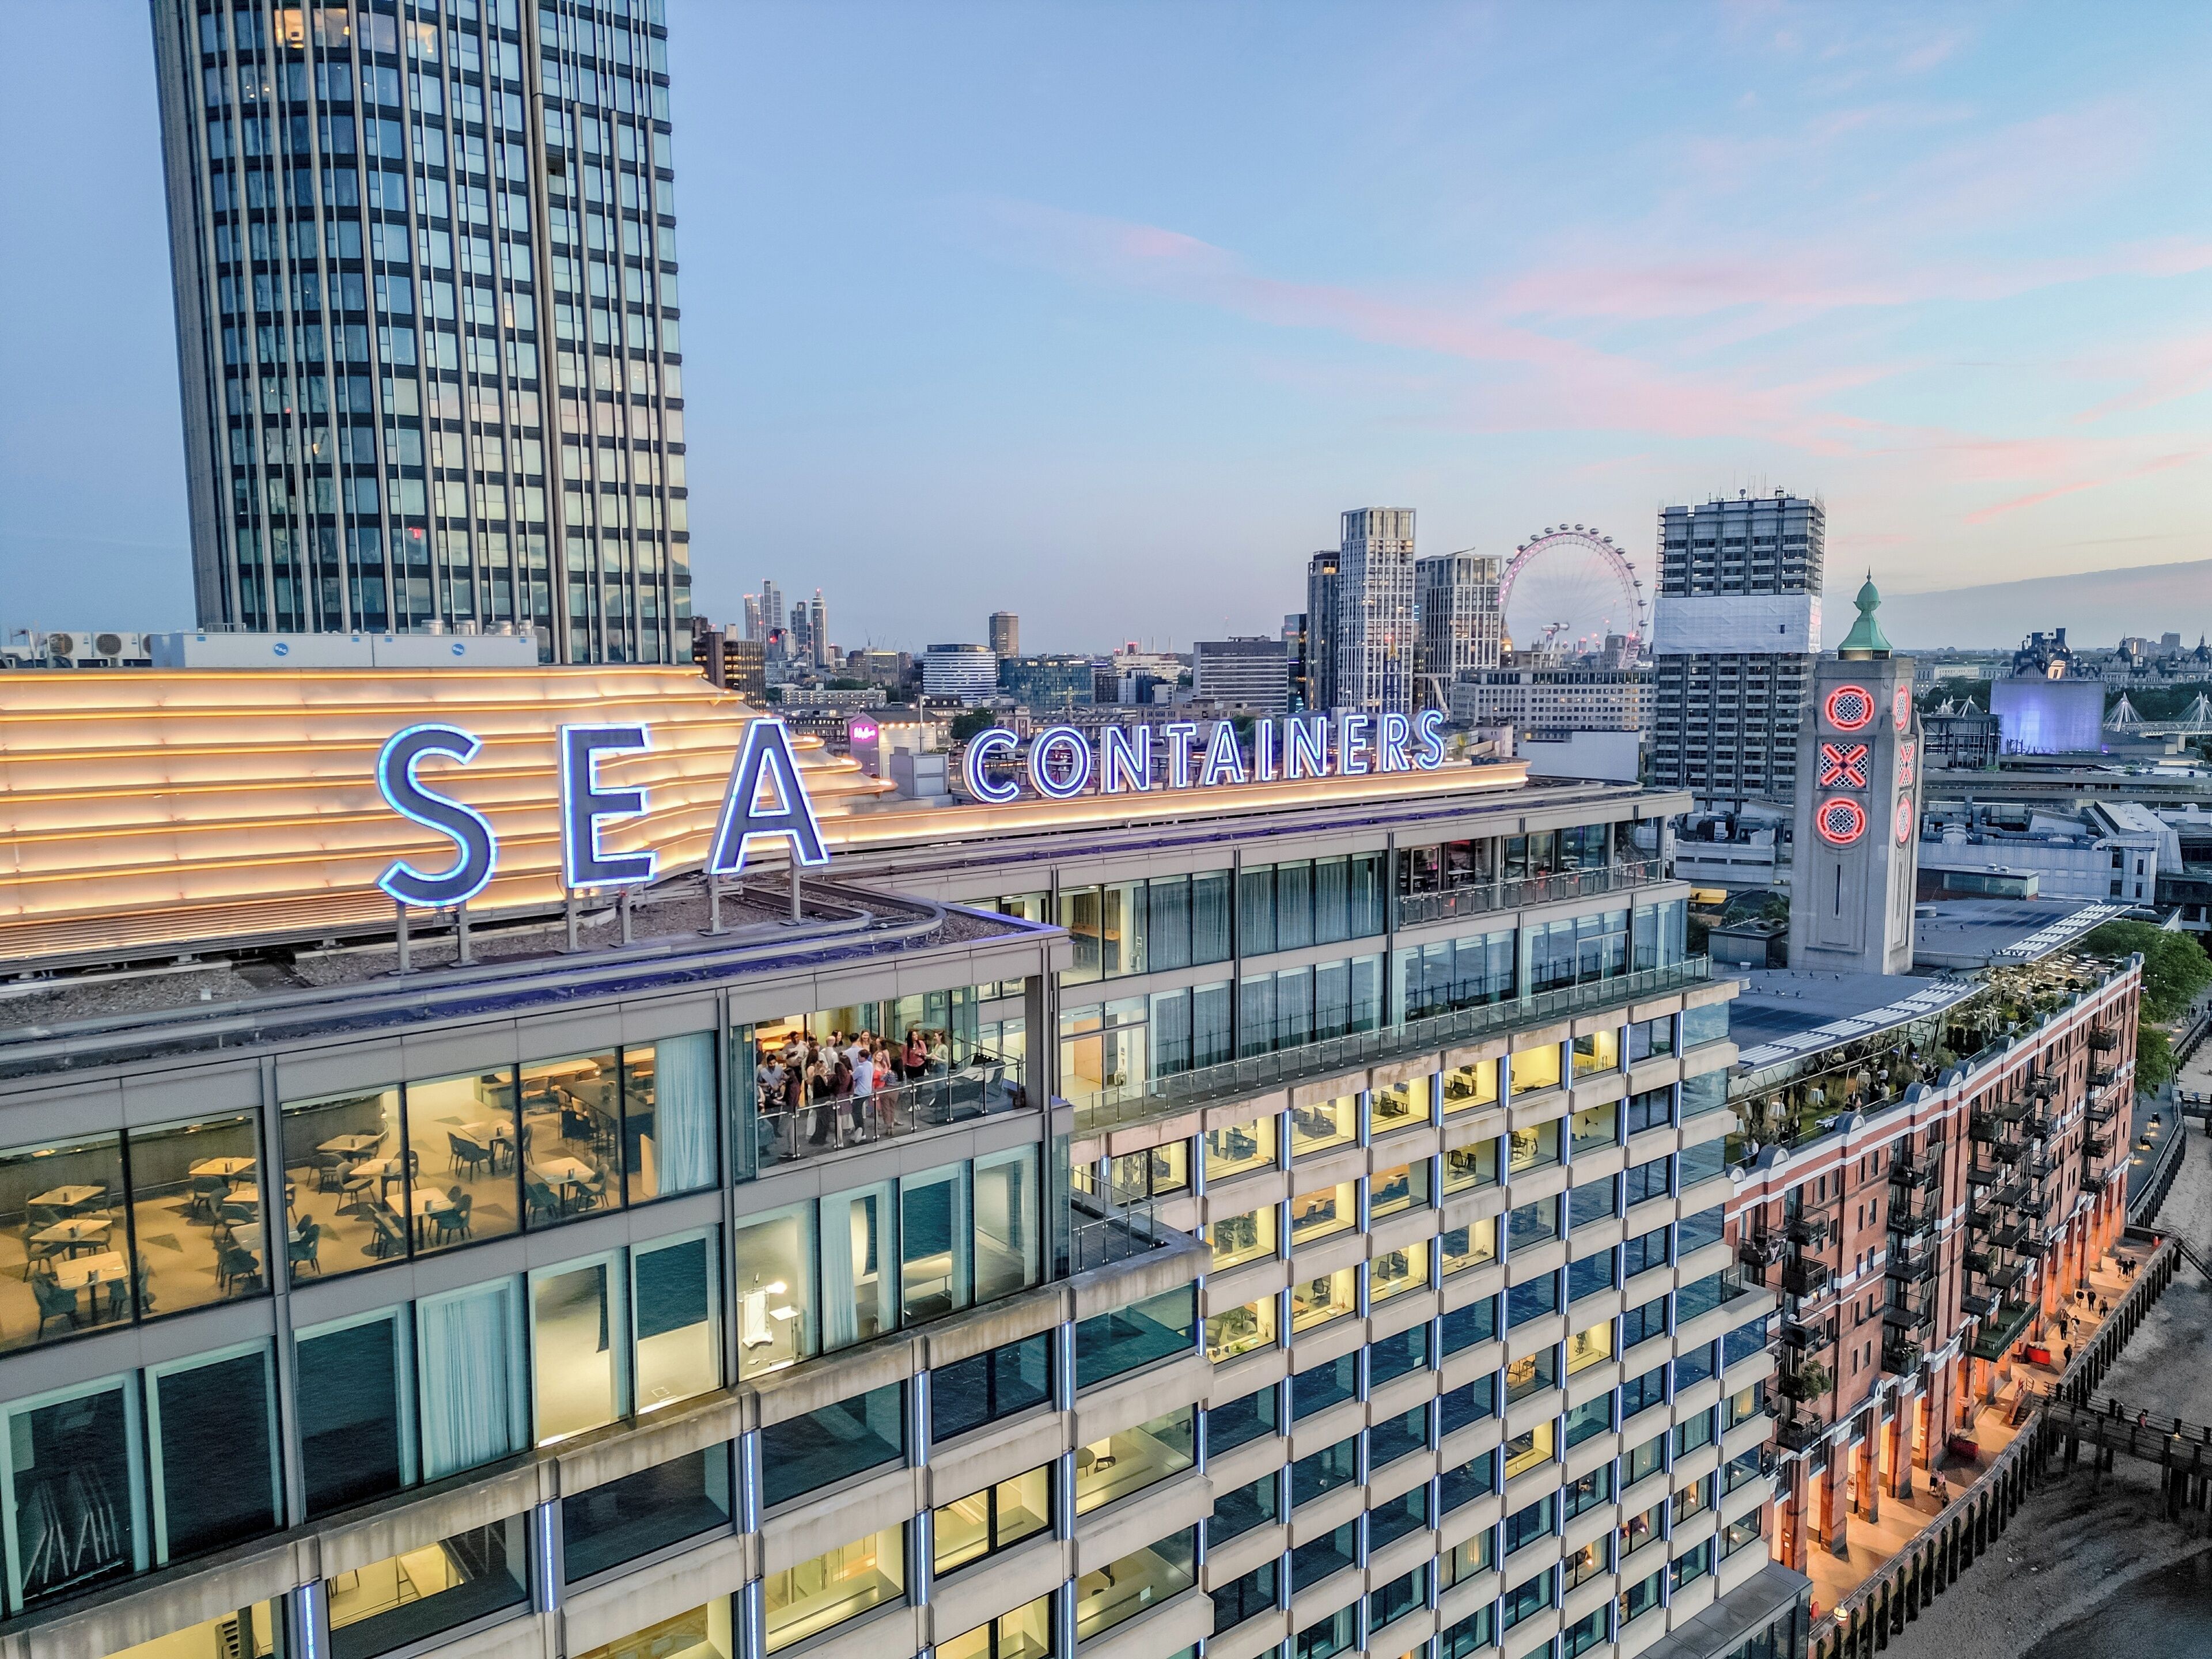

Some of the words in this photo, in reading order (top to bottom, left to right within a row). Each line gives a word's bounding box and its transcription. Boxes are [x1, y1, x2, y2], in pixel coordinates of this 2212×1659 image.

[376, 717, 831, 908] SEA
[963, 709, 1445, 804] CONTAINERS
[1816, 684, 1874, 844] OXO
